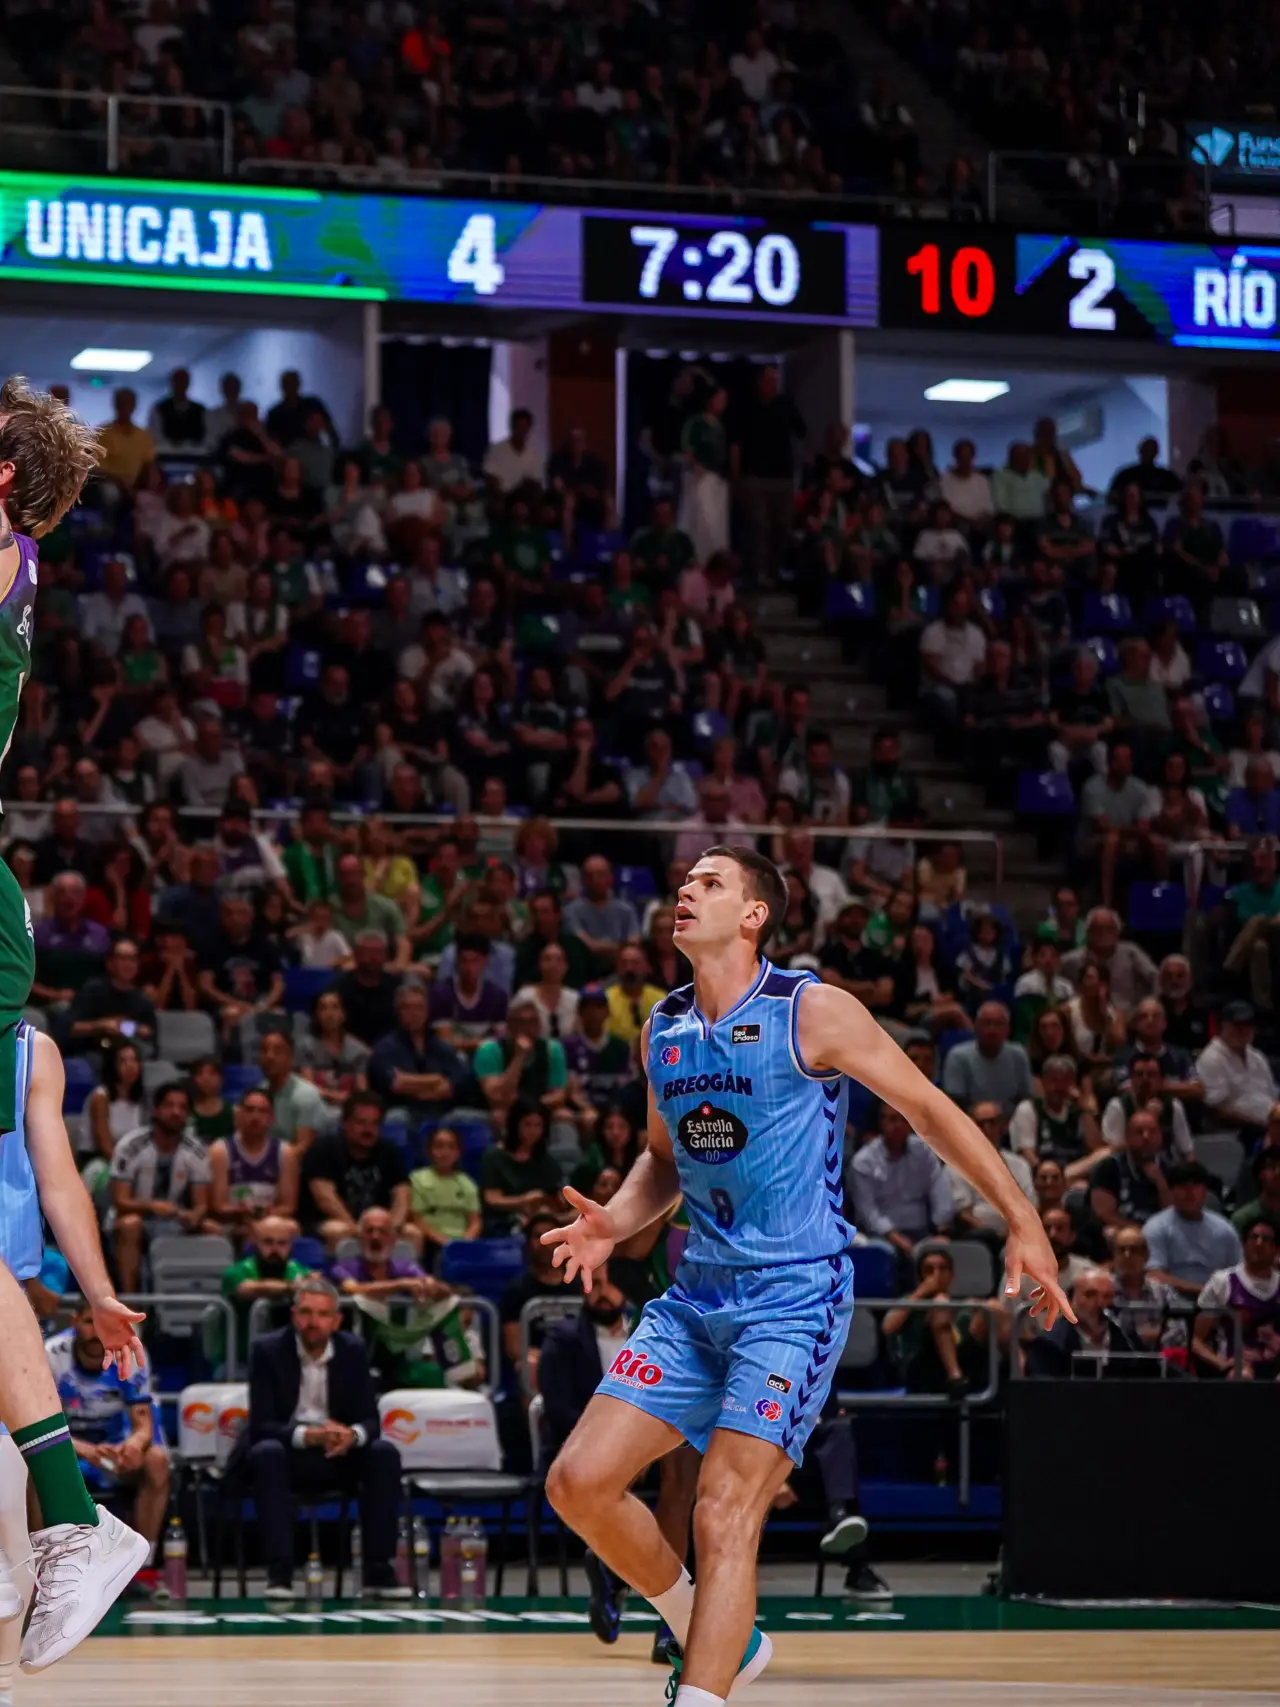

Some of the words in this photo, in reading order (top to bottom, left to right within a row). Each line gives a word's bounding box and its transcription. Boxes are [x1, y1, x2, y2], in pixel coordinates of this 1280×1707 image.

[25, 199, 273, 271] UNICAJA
[447, 213, 505, 295] 4
[630, 226, 800, 305] 7:20
[906, 243, 995, 317] 10
[1068, 248, 1116, 331] 2
[1193, 254, 1277, 329] RÍO
[664, 1070, 752, 1100] BREOGÁN
[686, 1119, 734, 1133] Estrella
[690, 1133, 734, 1149] Galicia
[608, 1349, 663, 1386] Río
[768, 1379, 786, 1392] acb
